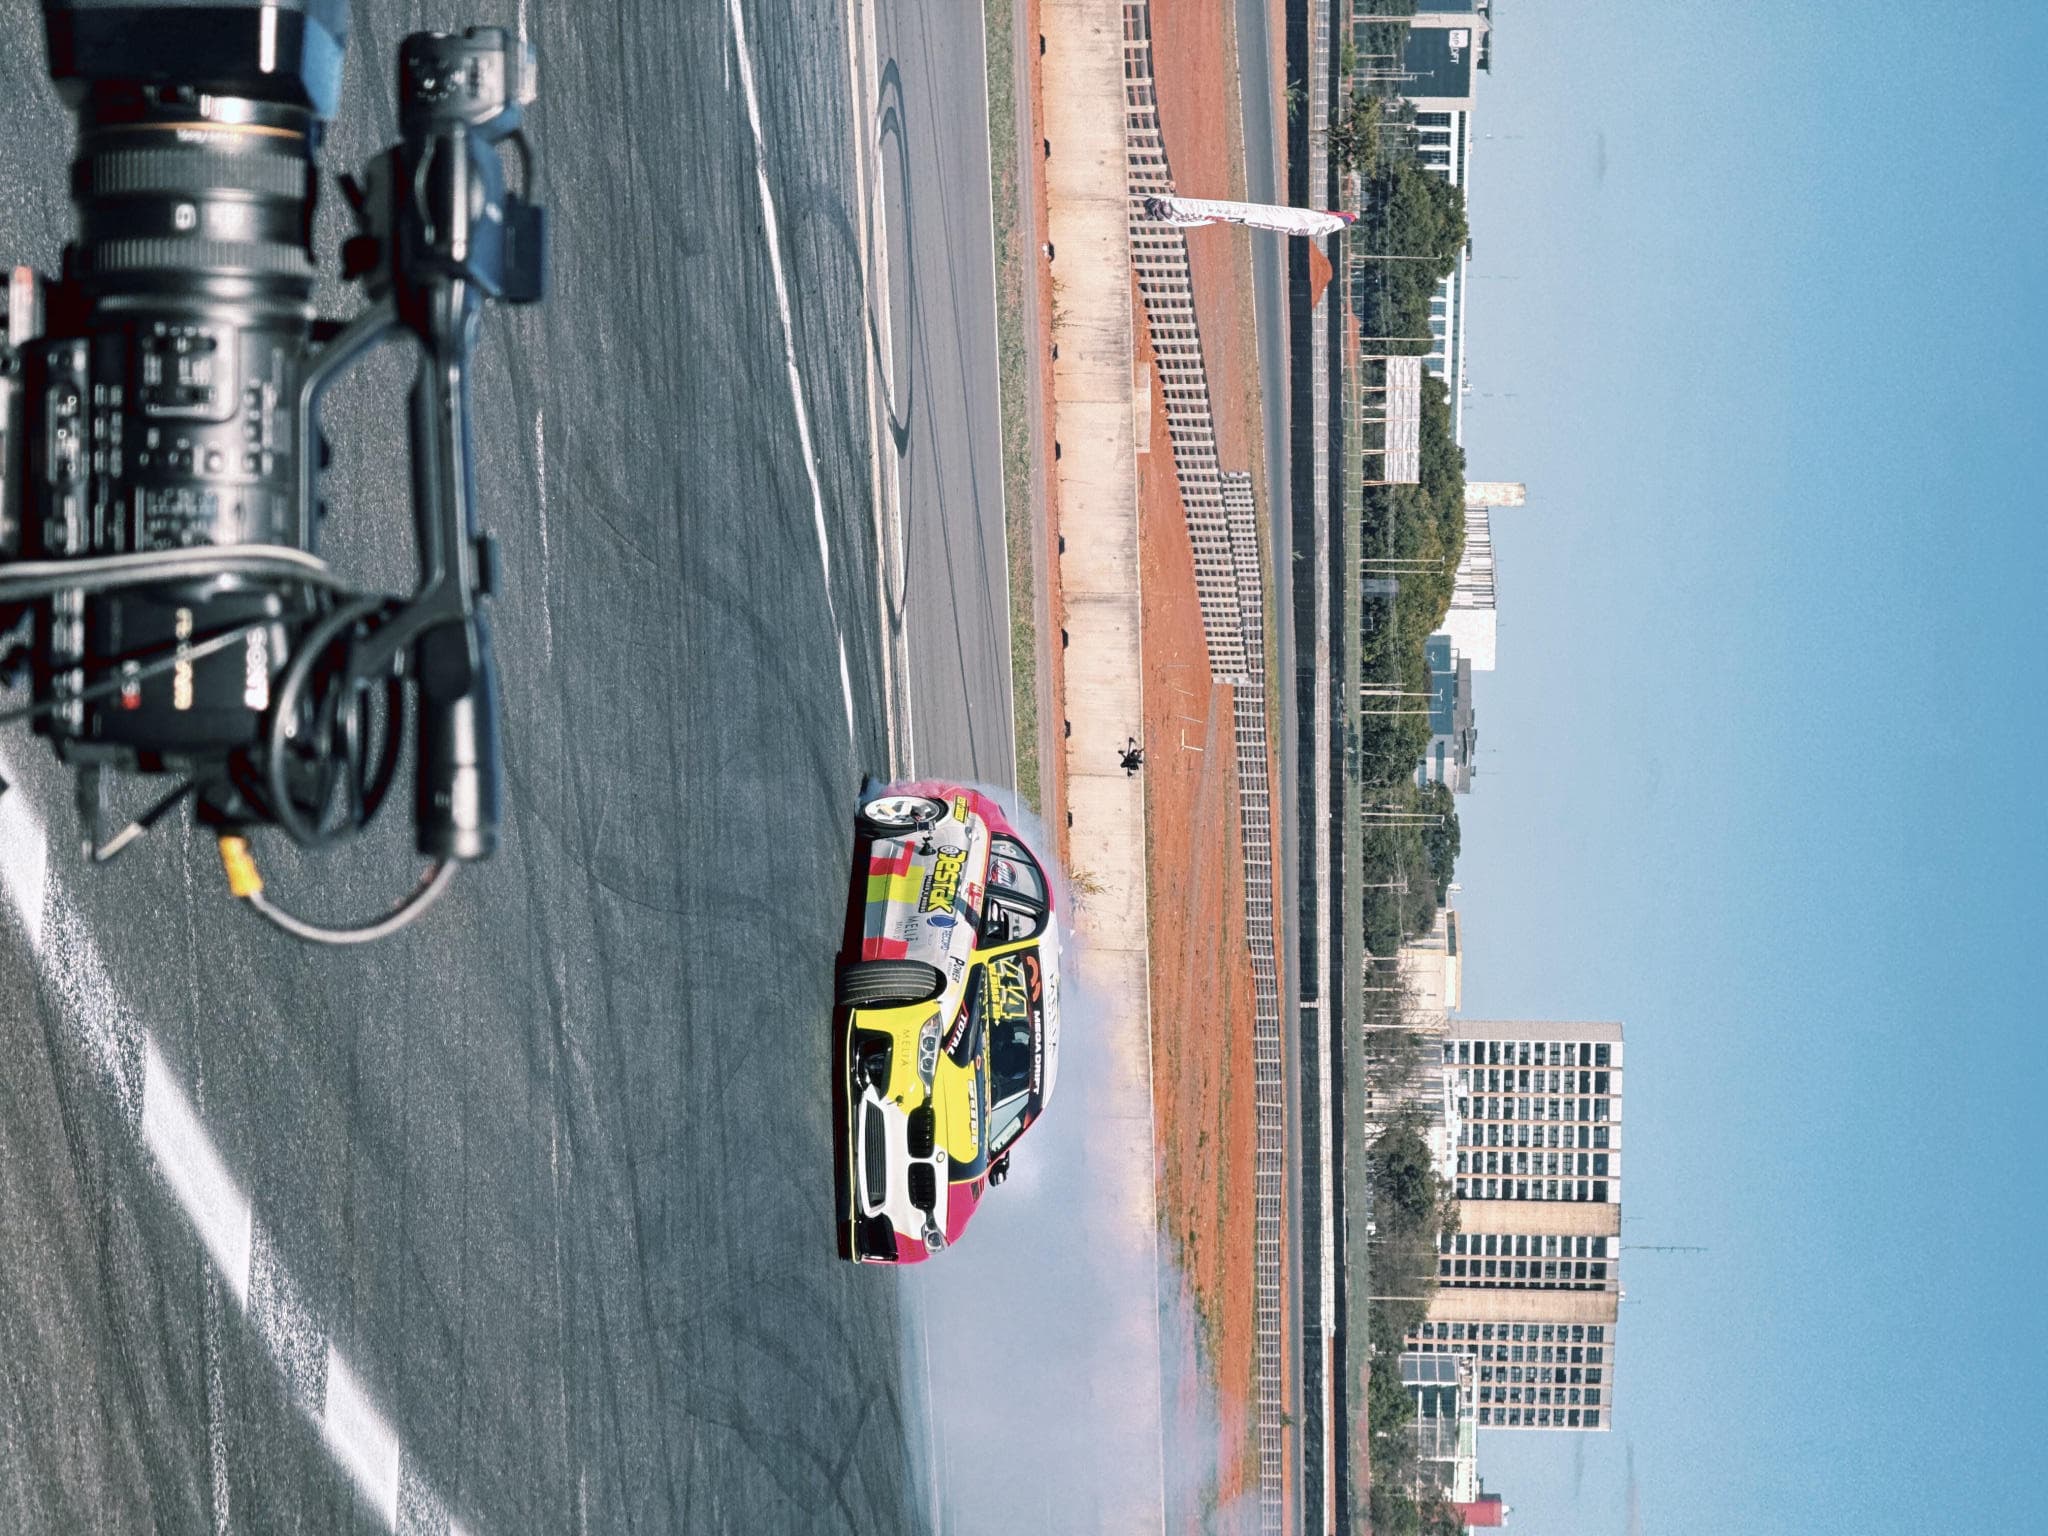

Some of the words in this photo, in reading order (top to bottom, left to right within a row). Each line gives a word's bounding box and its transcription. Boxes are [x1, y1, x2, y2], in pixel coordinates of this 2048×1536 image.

[999, 960, 1027, 1020] 44
[947, 1014, 967, 1056] TOTAL
[1033, 1010, 1042, 1053] MEGA
[1033, 1054, 1042, 1096] DRIFT
